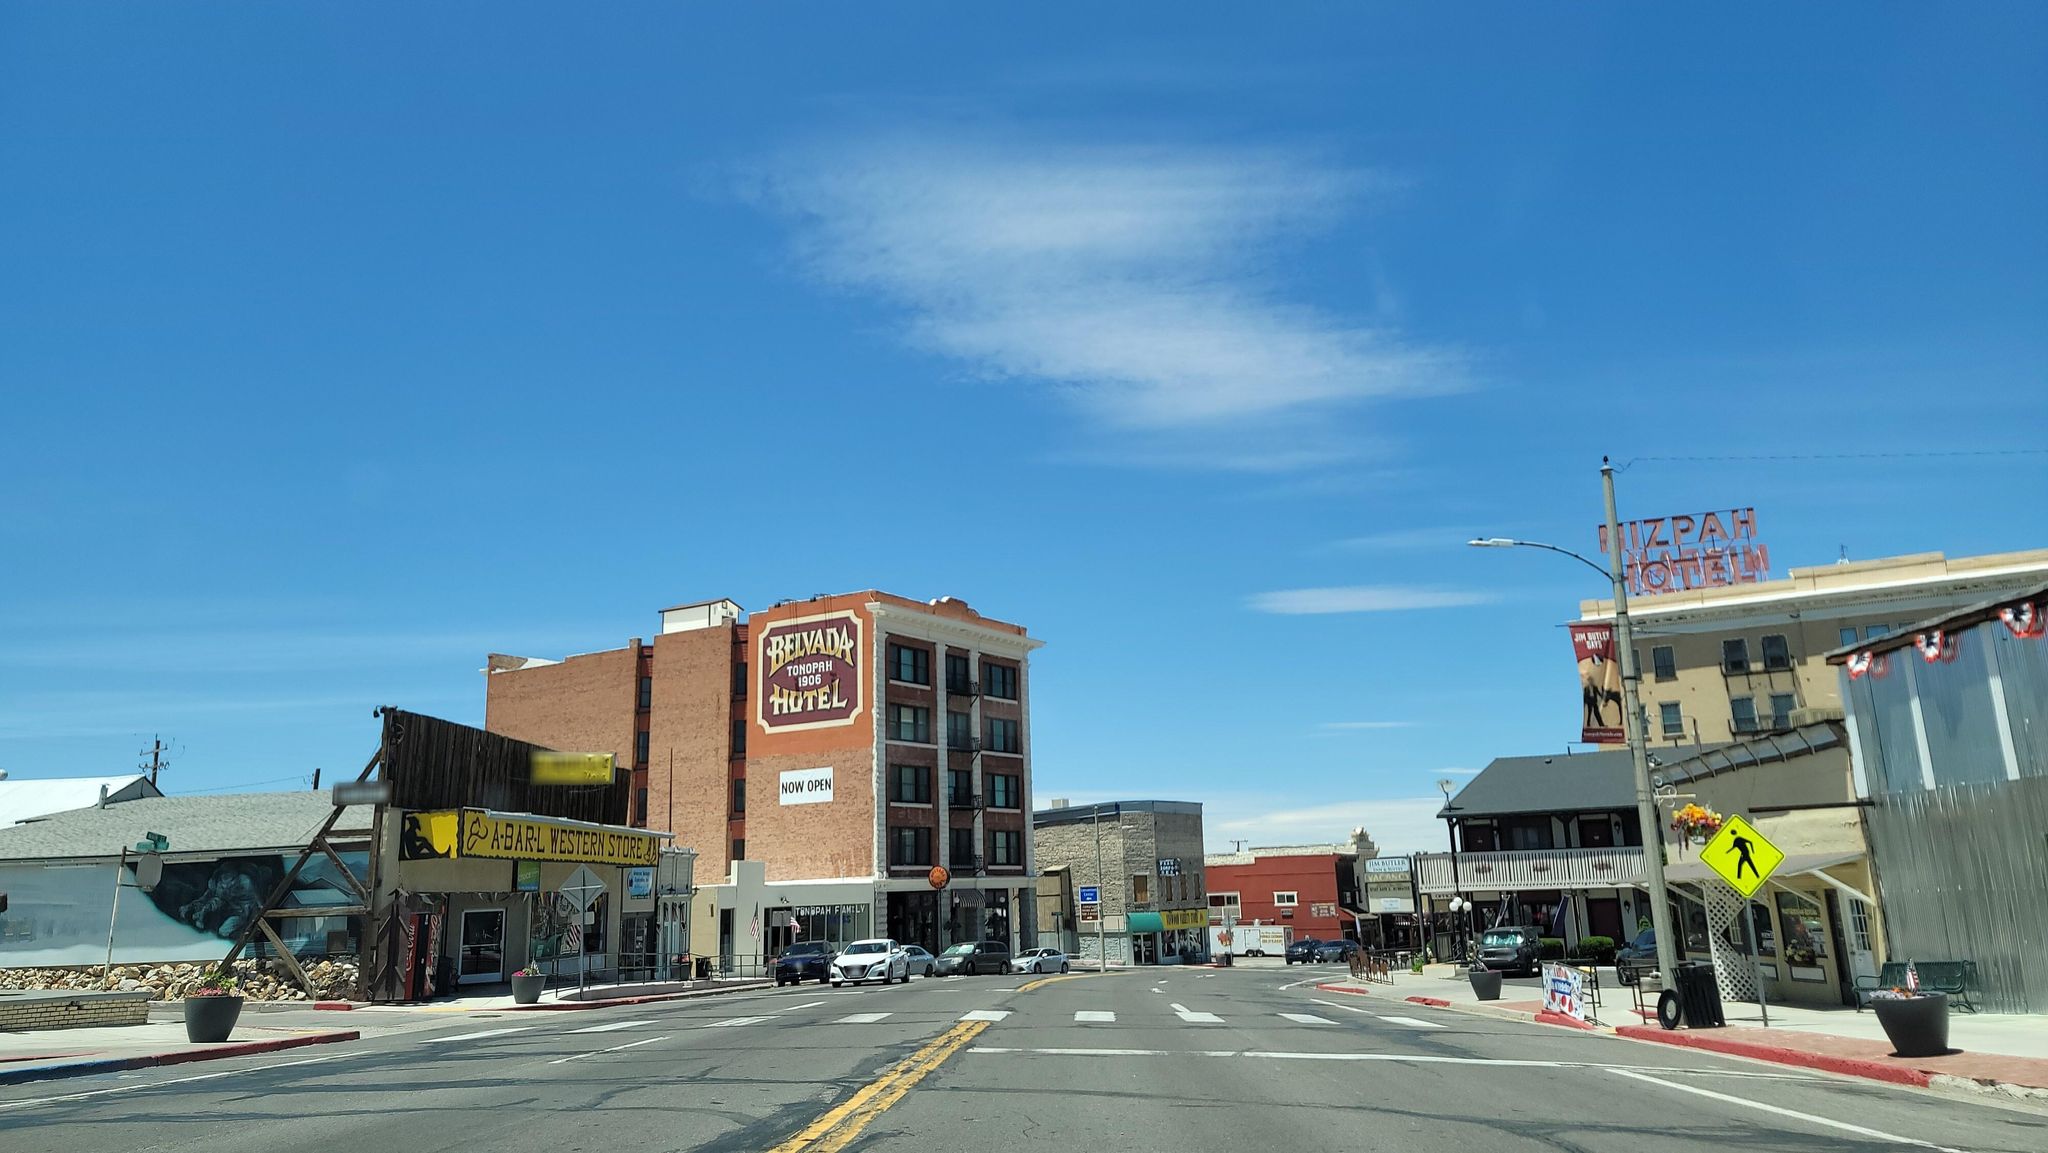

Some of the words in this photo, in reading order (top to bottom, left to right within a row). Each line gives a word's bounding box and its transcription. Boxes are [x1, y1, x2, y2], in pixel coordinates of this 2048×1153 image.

[766, 624, 855, 677] BELVADA
[787, 660, 833, 677] TONOPAH
[798, 674, 822, 688] 1906
[769, 678, 848, 716] HOTEL
[781, 780, 804, 795] NOW
[807, 776, 832, 792] OPEN
[550, 828, 605, 858] WESTERN
[608, 835, 643, 860] STORE
[796, 906, 831, 916] TONOPAH
